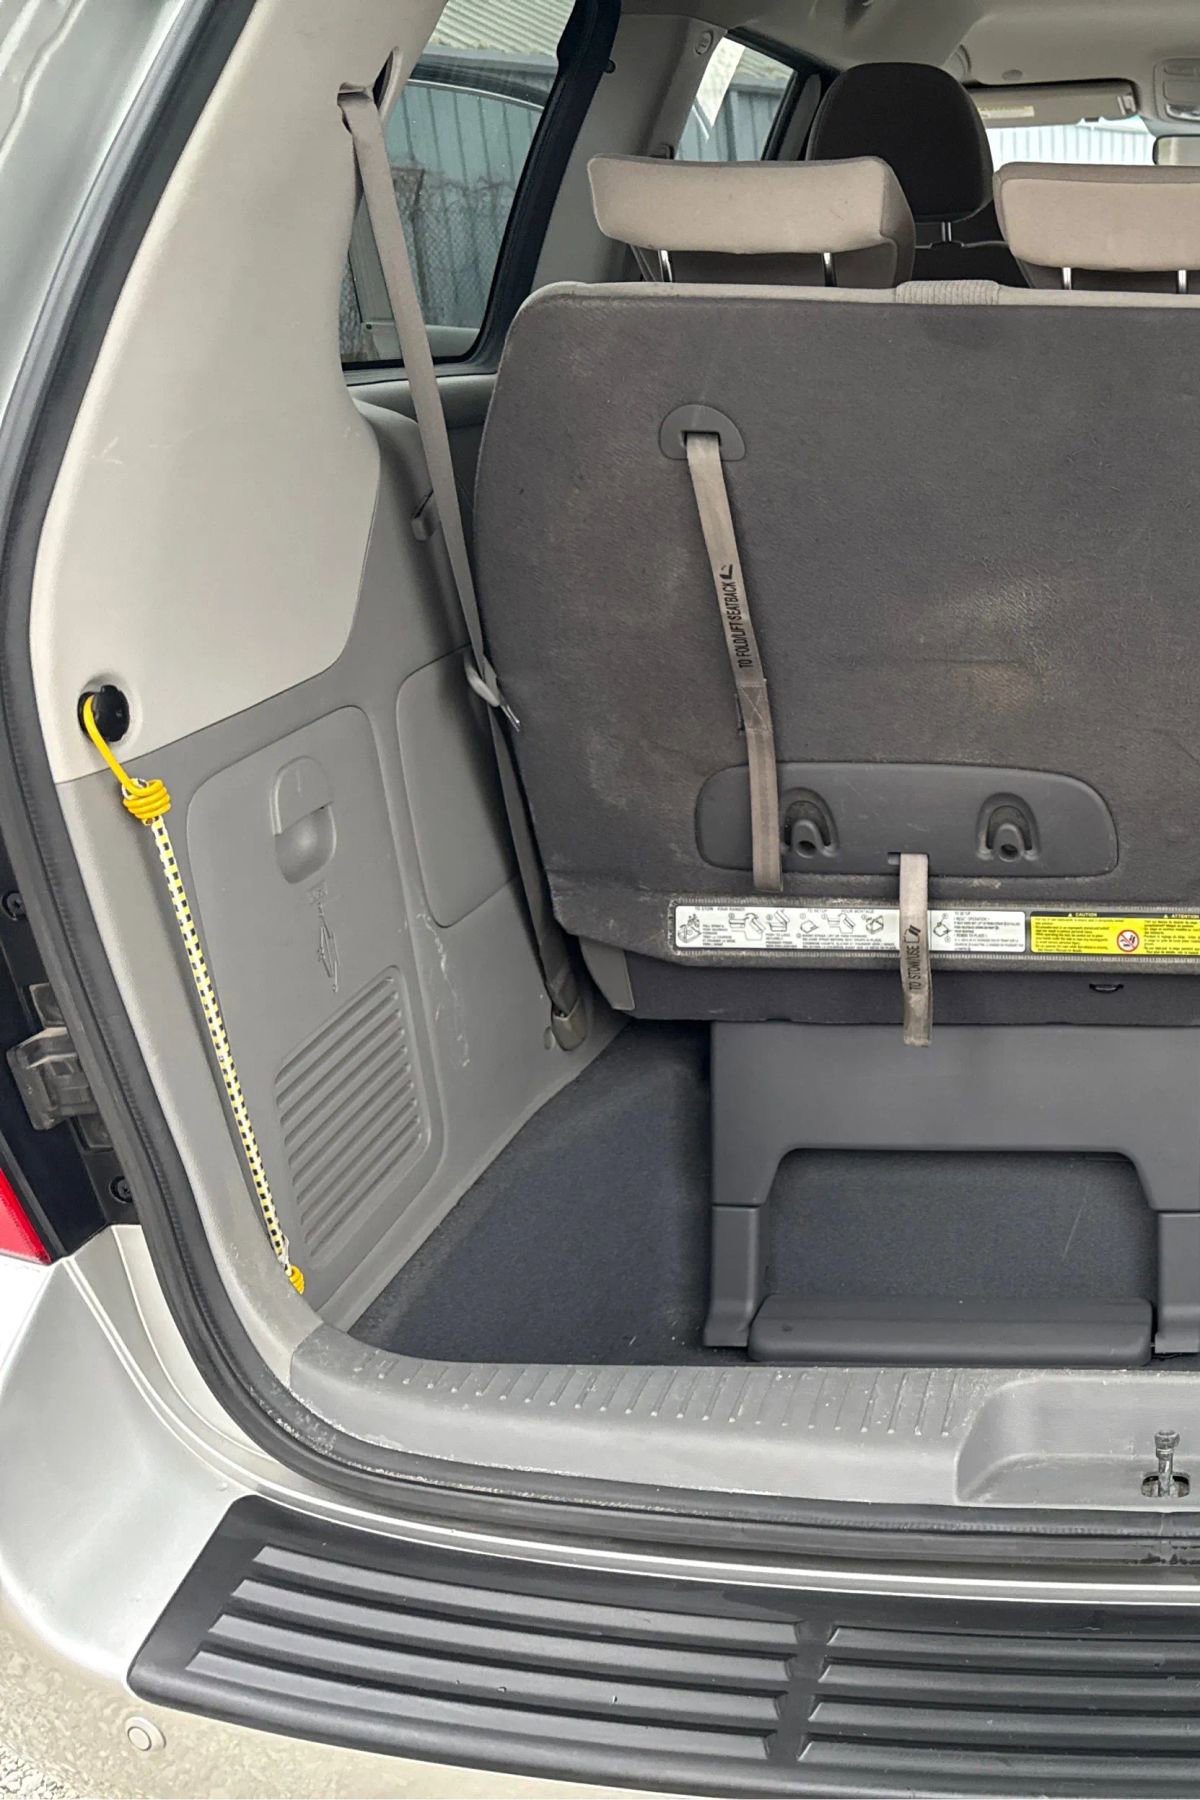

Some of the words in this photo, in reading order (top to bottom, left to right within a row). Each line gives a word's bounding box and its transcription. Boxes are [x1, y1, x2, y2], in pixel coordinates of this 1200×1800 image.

[721, 581, 742, 620] SEATBACK
[729, 621, 749, 657] FOLD/LIFT
[739, 658, 753, 669] TO
[906, 945, 922, 979] STOW/USE
[908, 981, 922, 991] TO
